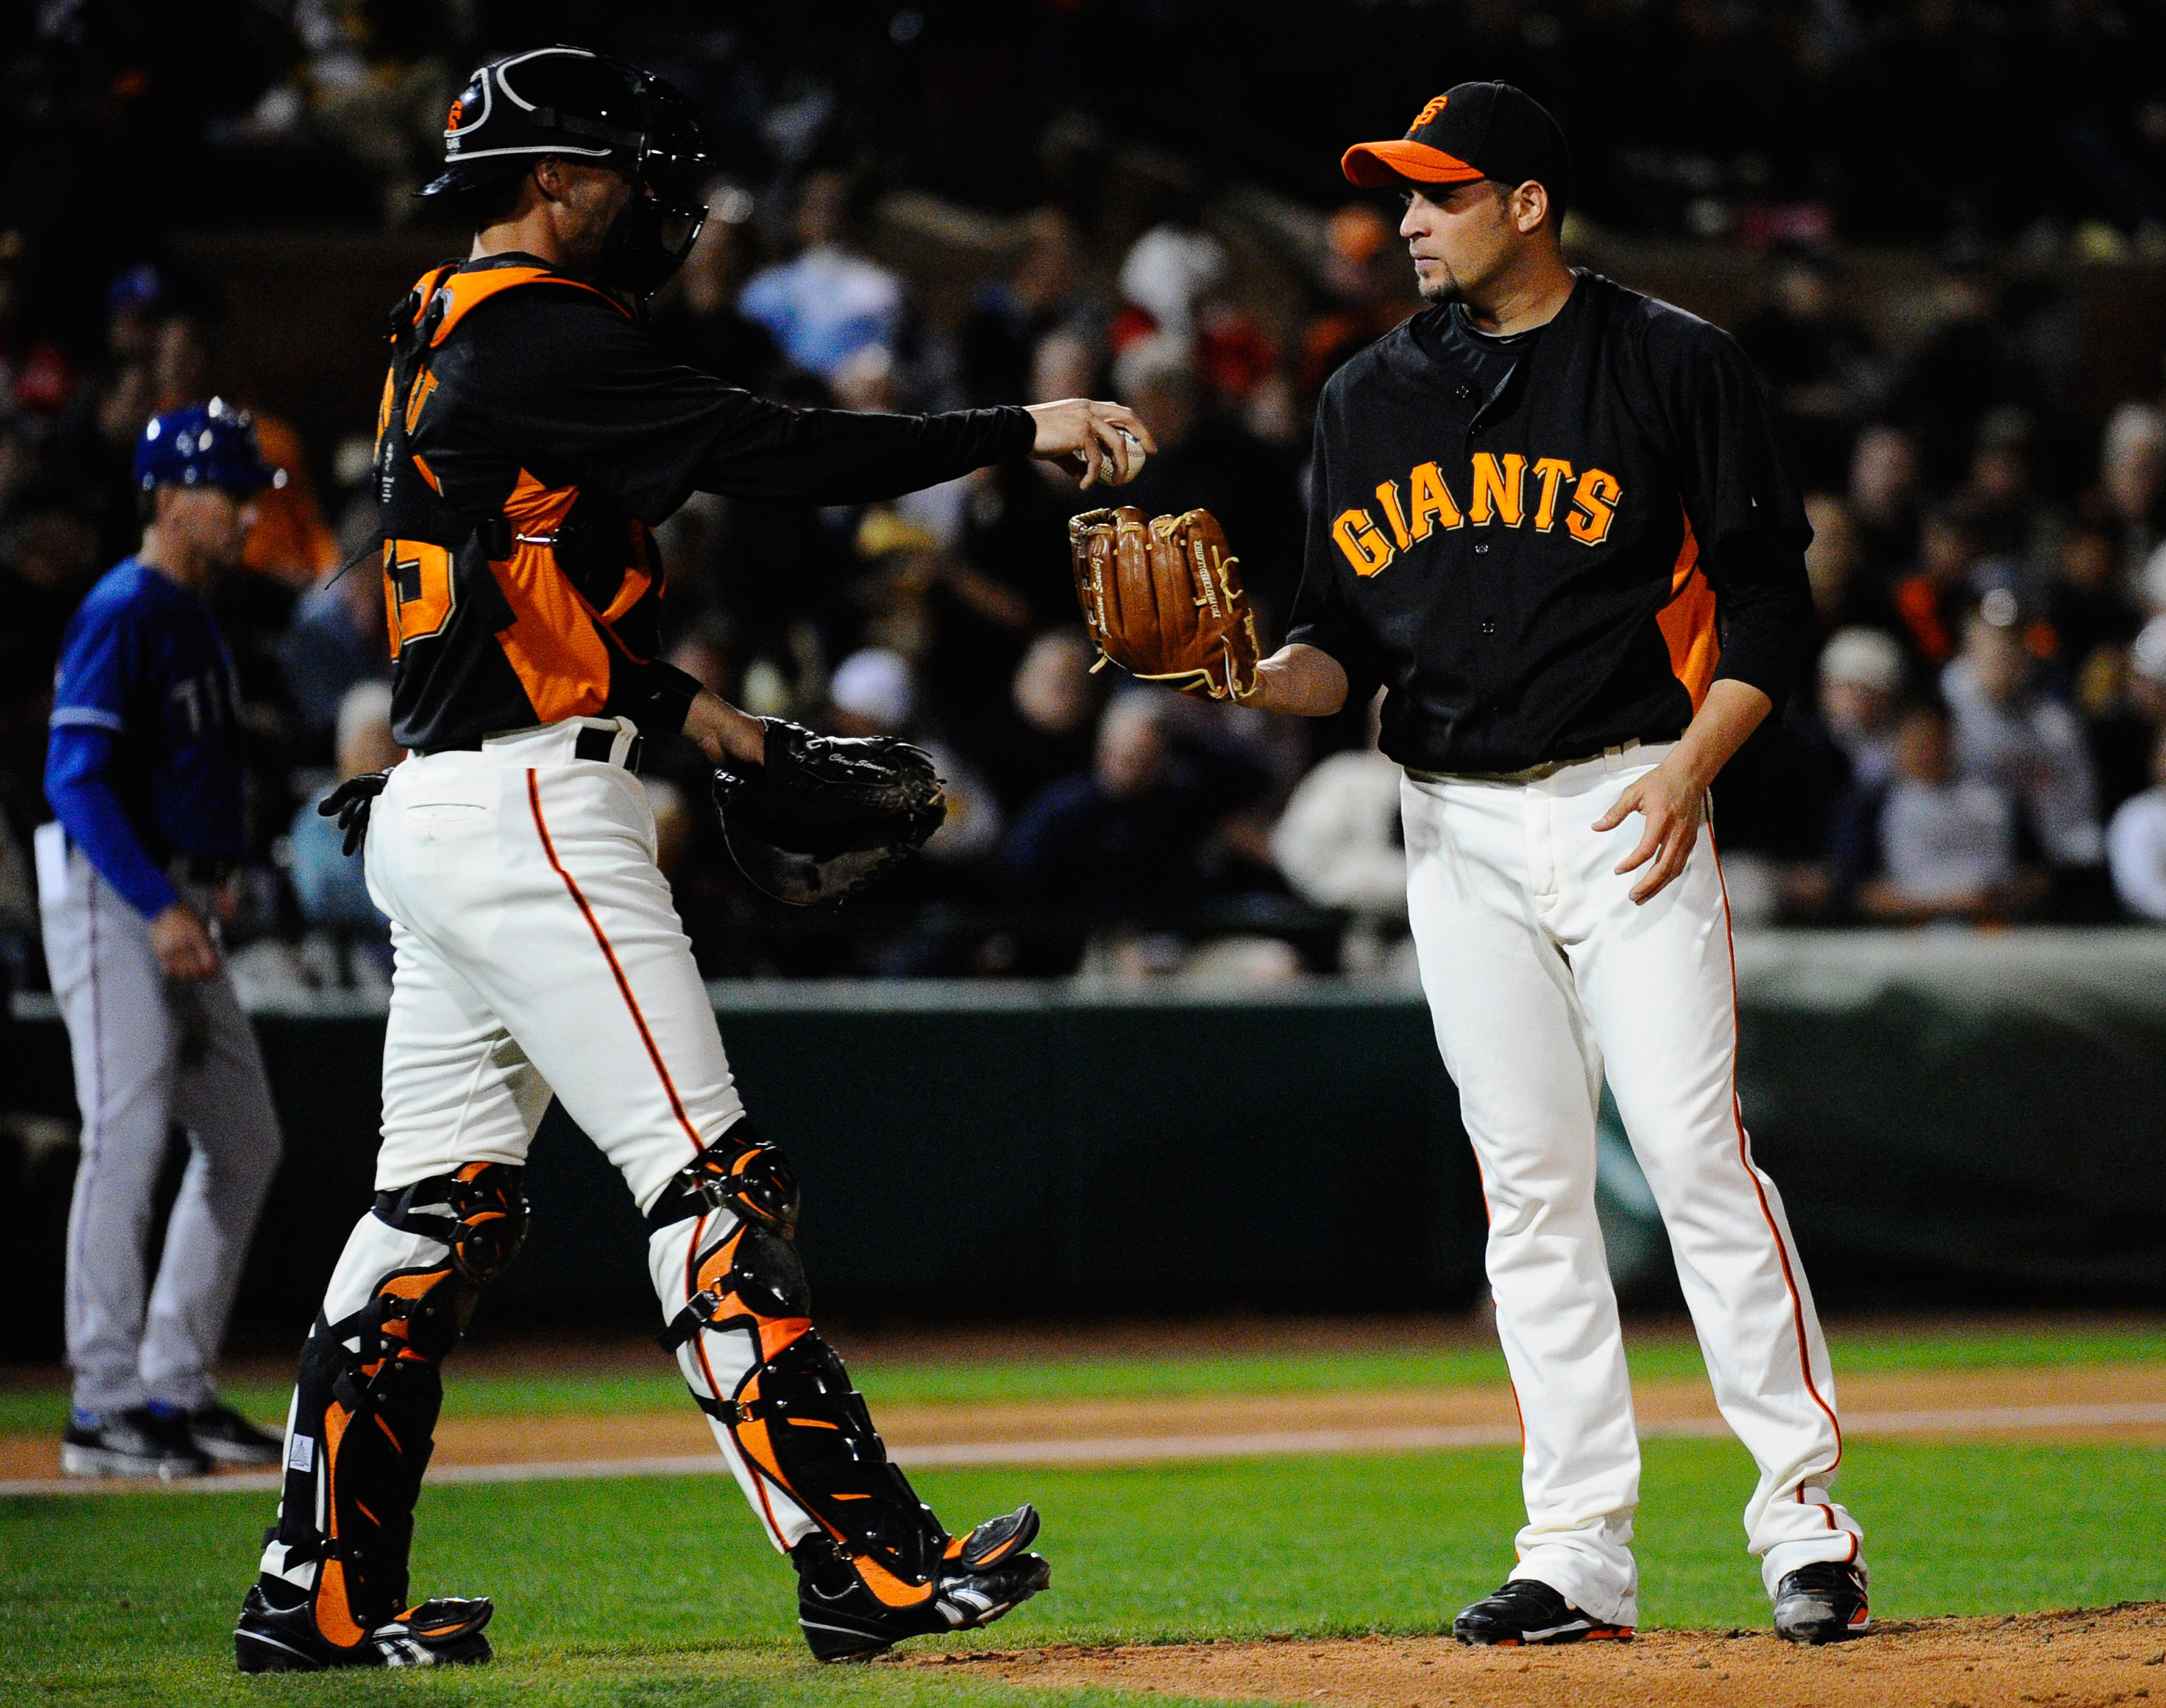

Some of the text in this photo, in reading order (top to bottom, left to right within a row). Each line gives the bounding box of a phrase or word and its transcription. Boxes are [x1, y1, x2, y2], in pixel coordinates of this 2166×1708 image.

[1332, 452, 1622, 578] GIANTS
[1193, 540, 1221, 619] PRO PREFERRED LEATHER
